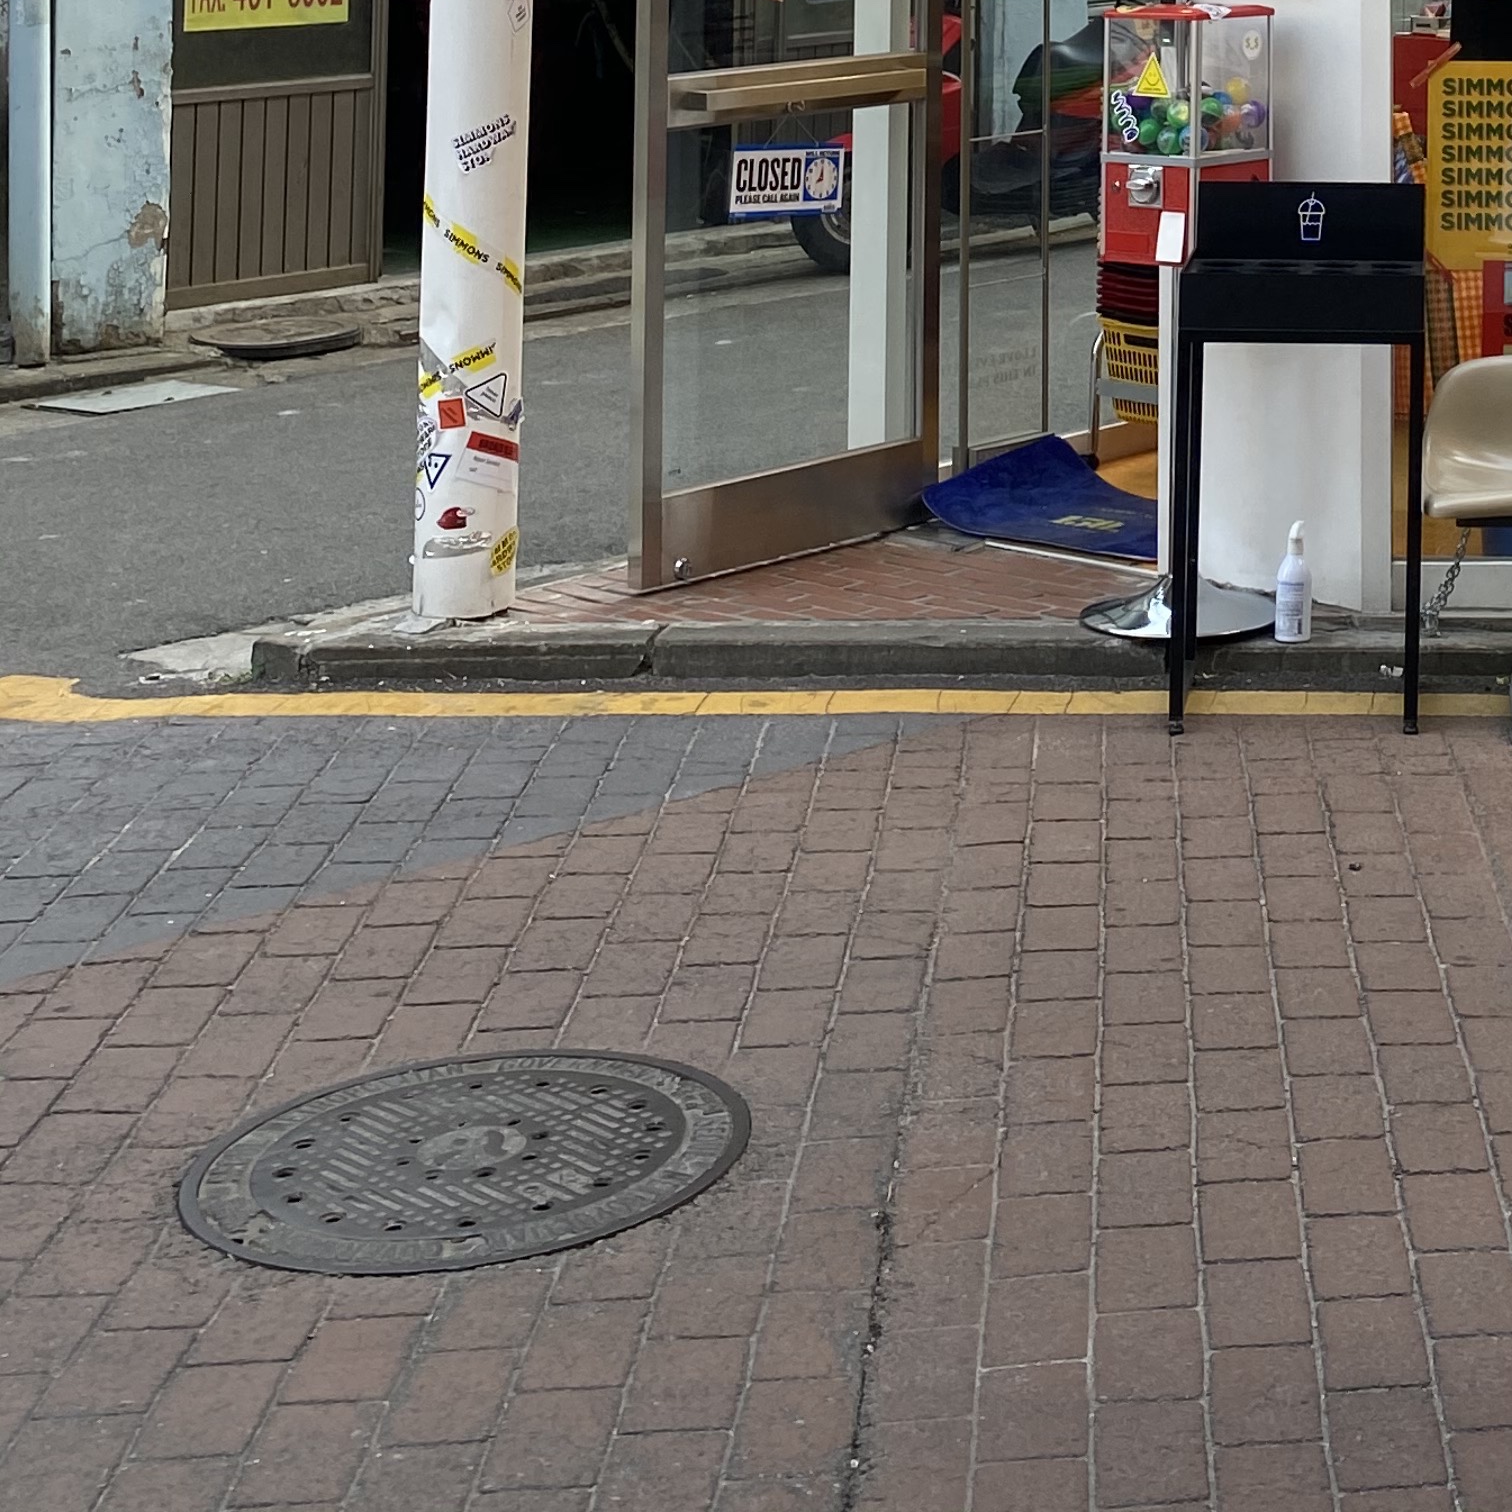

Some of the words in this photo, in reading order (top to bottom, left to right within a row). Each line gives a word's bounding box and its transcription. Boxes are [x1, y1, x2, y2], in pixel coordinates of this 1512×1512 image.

[736, 157, 802, 193] CLOSED
[735, 193, 761, 205] PLEASE
[762, 194, 778, 204] CALL
[780, 193, 799, 203] AGAIN
[444, 229, 489, 264] SIMMONS
